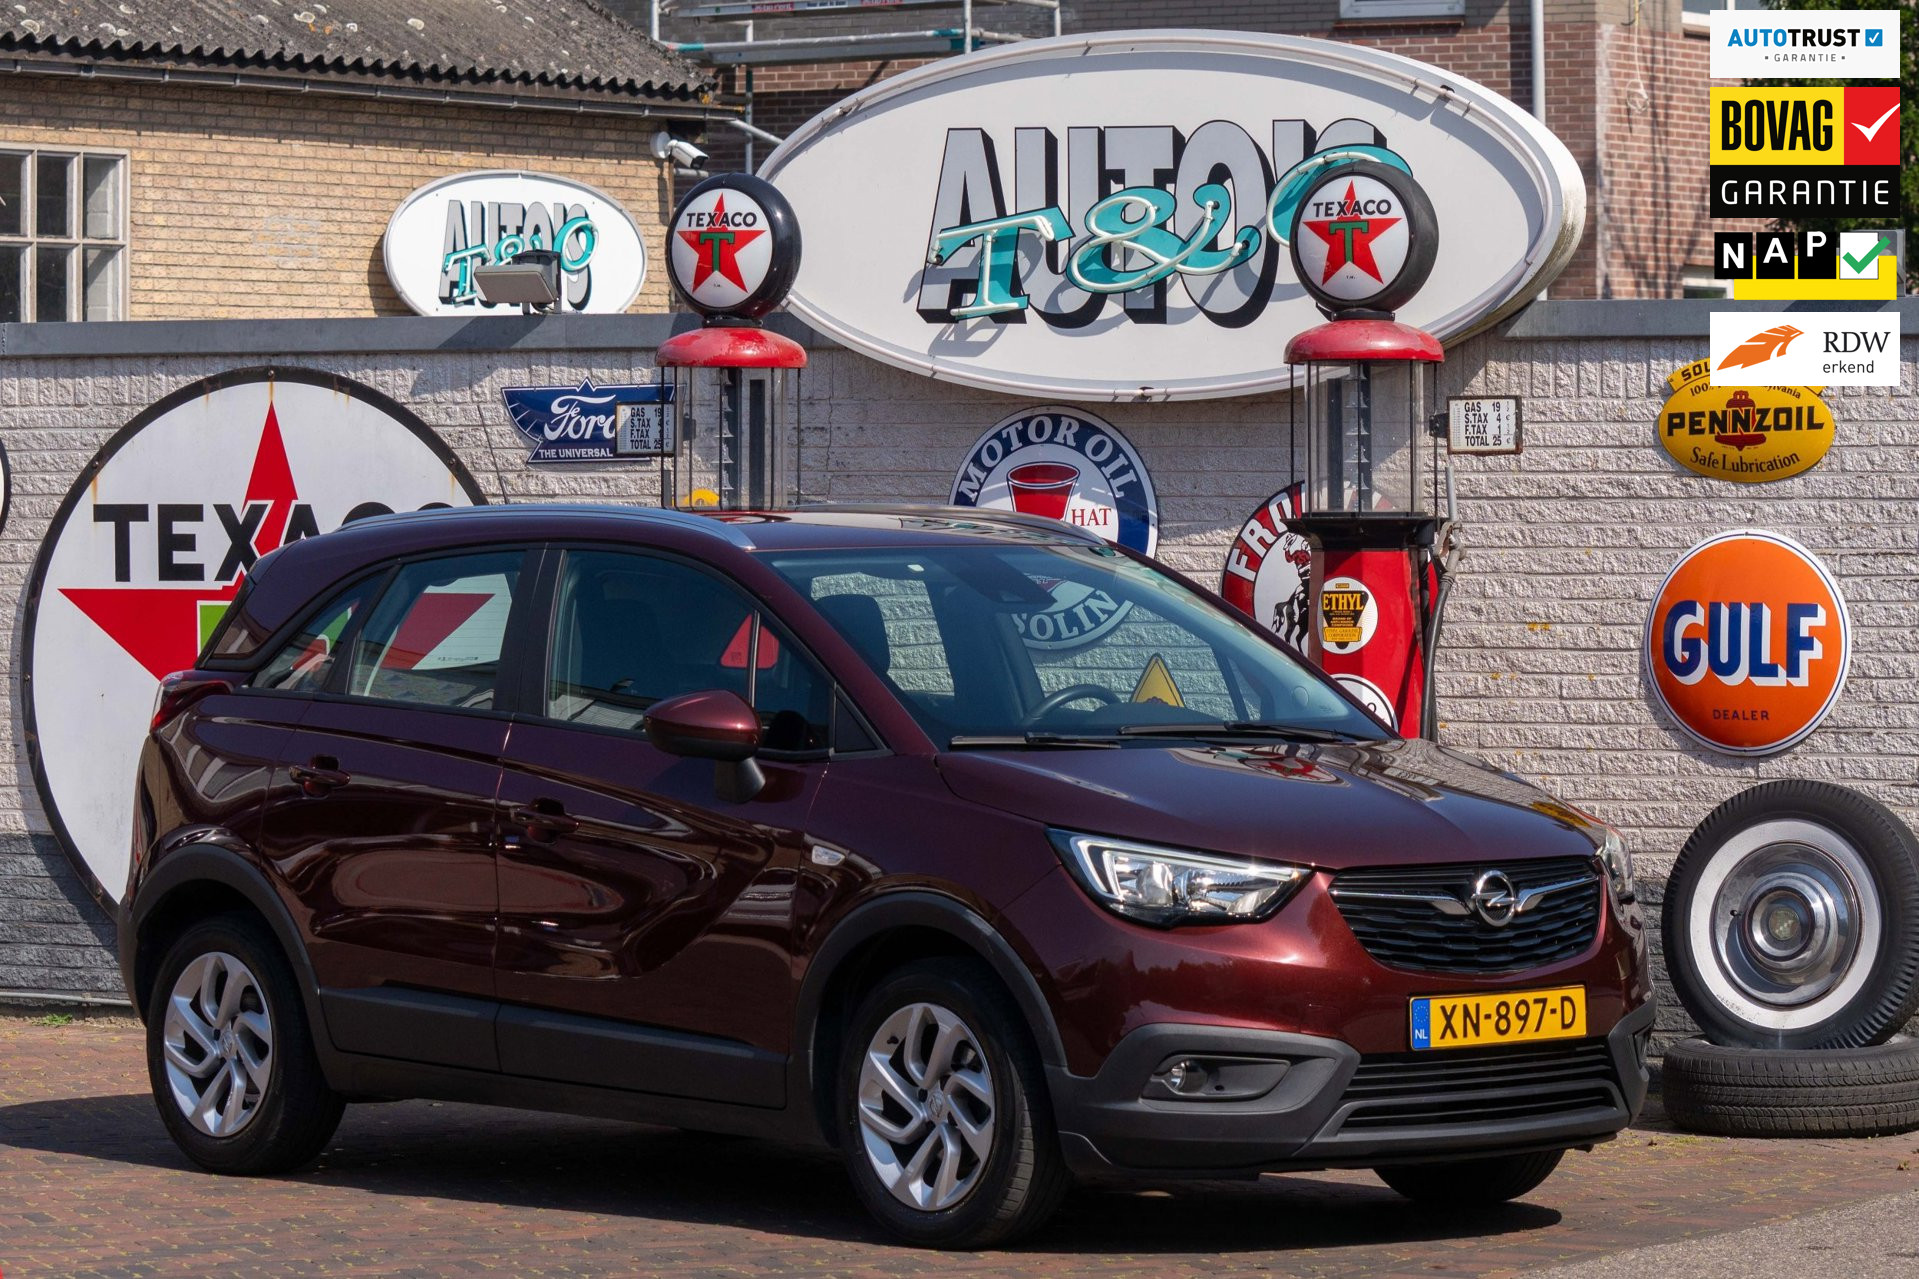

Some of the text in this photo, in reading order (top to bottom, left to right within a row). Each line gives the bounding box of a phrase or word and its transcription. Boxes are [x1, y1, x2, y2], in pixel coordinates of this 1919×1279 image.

[1313, 199, 1392, 217] TEXACO
[686, 211, 758, 228] TEXACO
[630, 407, 646, 418] GAS
[1464, 401, 1481, 413] GAS
[1492, 401, 1501, 413] 19
[630, 418, 651, 429] S.TAX
[1464, 413, 1489, 424] S.TAX
[1496, 413, 1502, 424] 4
[1667, 405, 1825, 437] PENNZOIL
[630, 429, 650, 439] F.TAX
[1464, 424, 1487, 435] F.TAX
[630, 439, 651, 450] TOTAL
[1465, 436, 1490, 447] TOTAL
[539, 448, 614, 459] THE UNIVERSAL
[958, 415, 1137, 502] MOTOR OIL
[1690, 446, 1800, 473] Safe Lubrication
[1071, 507, 1112, 527] HAT
[1323, 593, 1365, 611] ETHYL
[1663, 600, 1827, 687] GULF
[1712, 709, 1770, 721] DEALER
[1414, 995, 1577, 1040] NL XN-897-D
